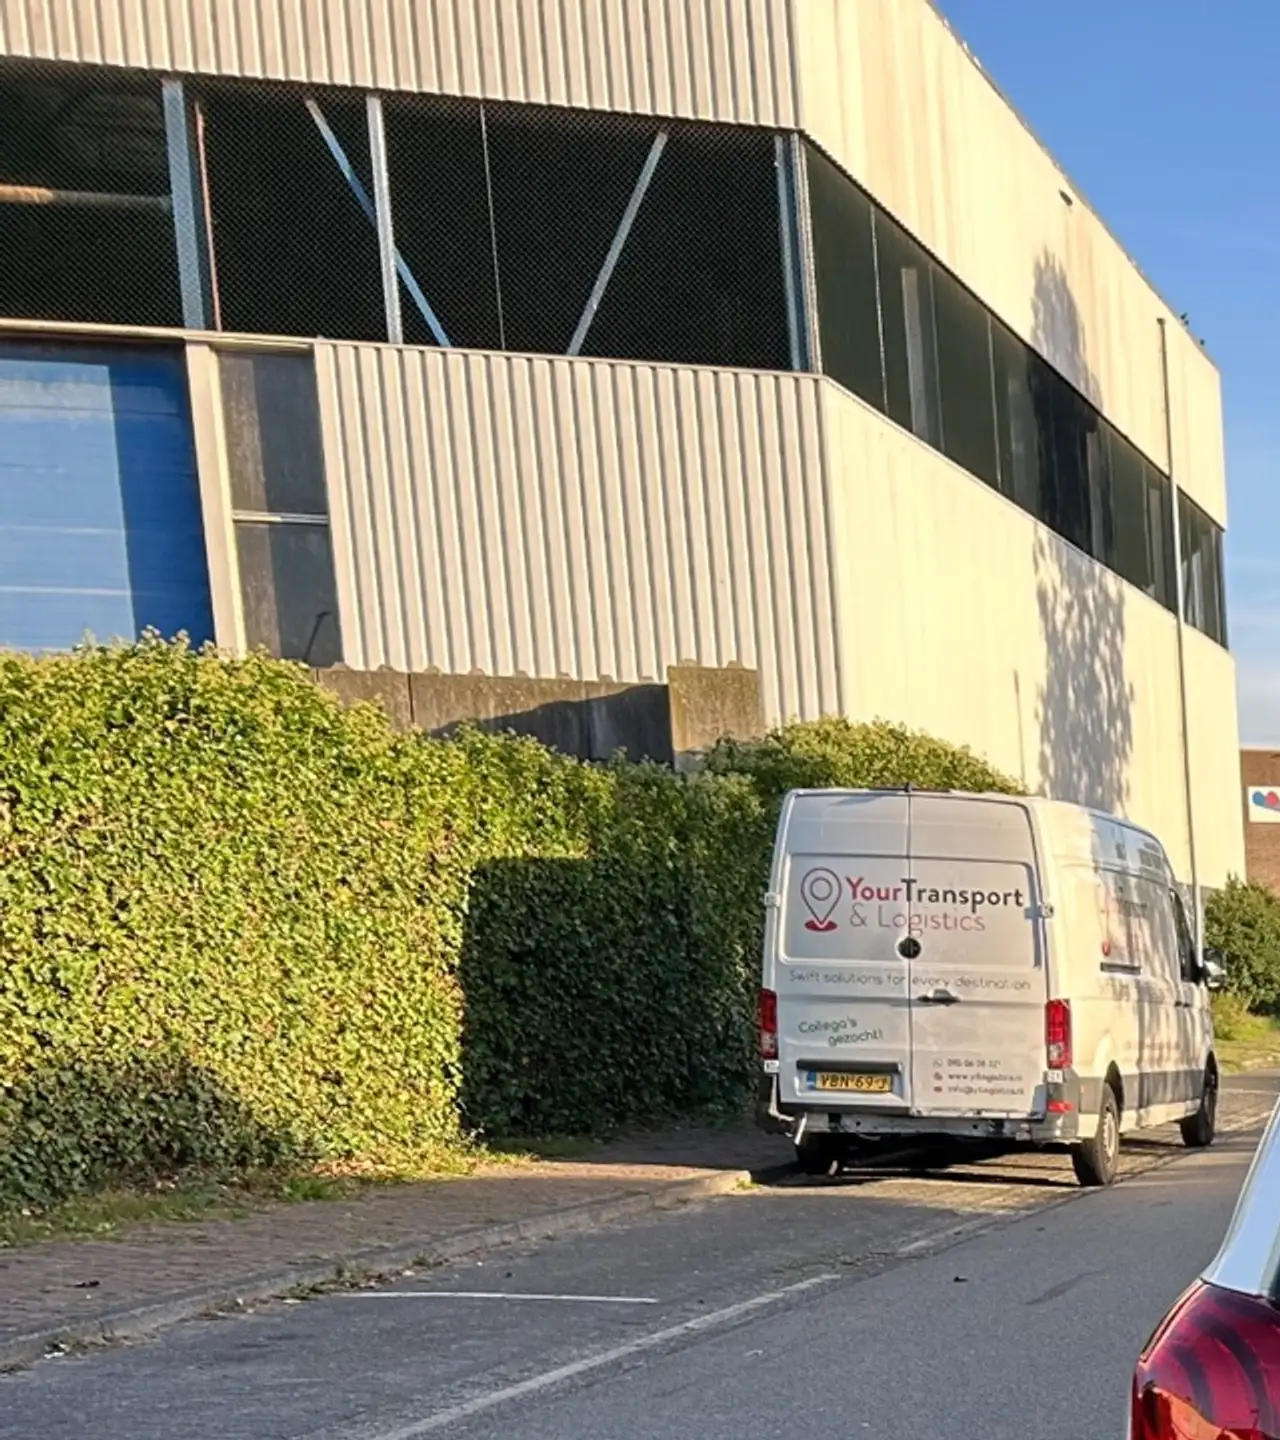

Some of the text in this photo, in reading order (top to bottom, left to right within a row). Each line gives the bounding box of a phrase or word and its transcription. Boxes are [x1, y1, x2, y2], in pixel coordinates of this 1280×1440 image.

[846, 876, 1024, 914] YourTransport
[850, 902, 986, 938] & Logistics
[824, 972, 883, 985] solutions
